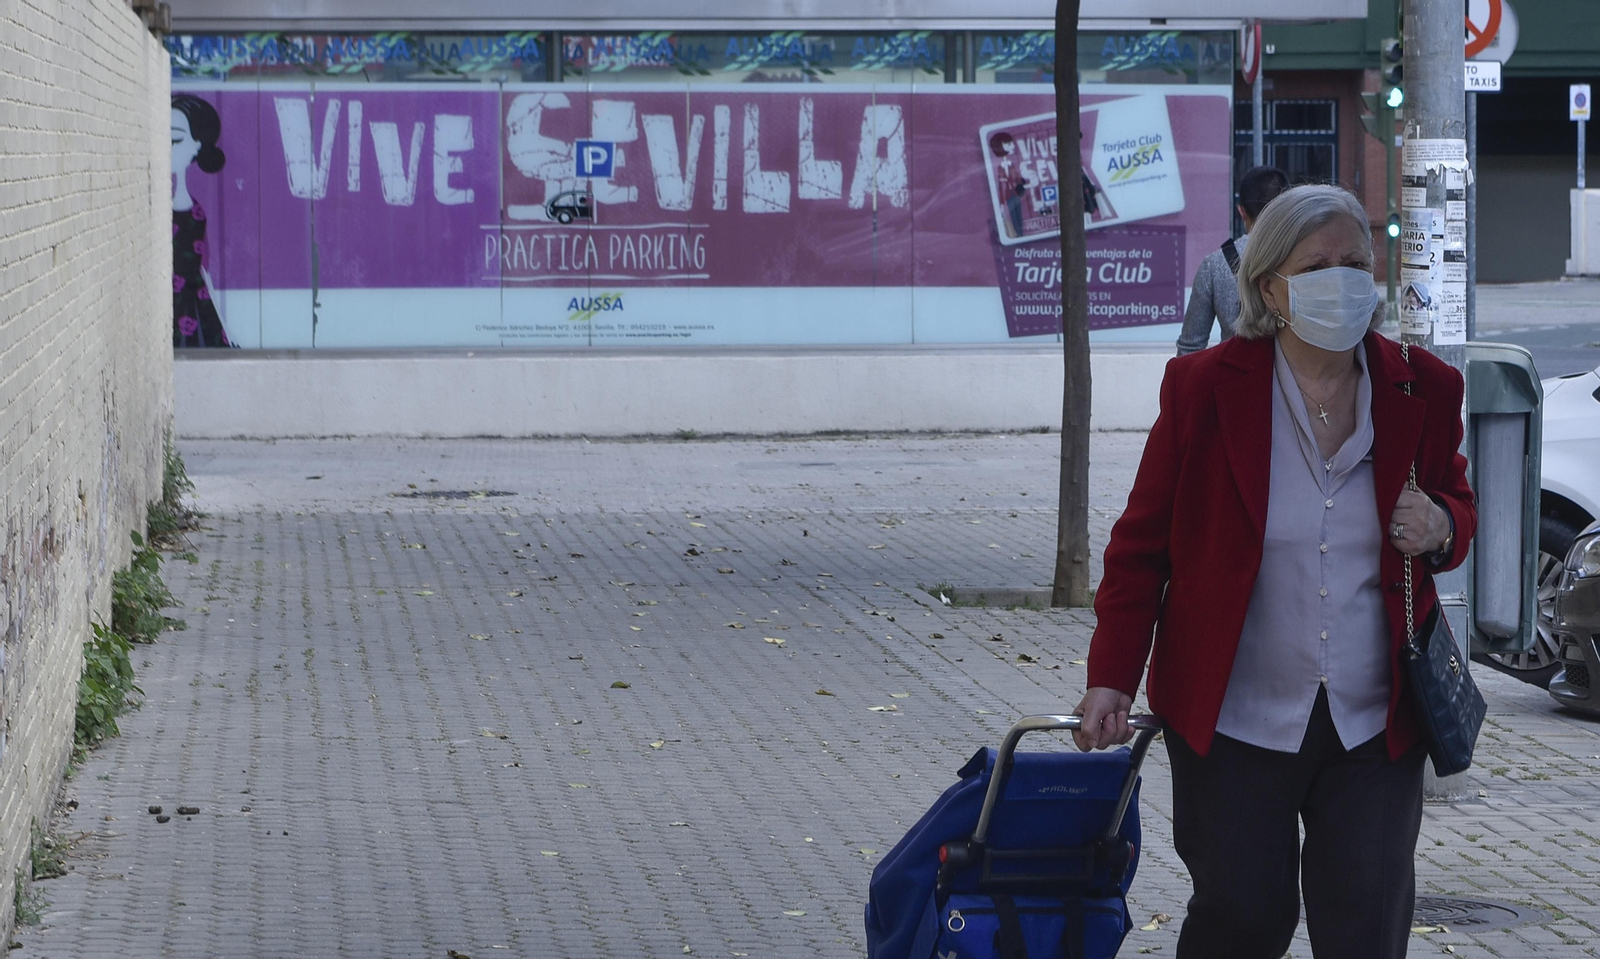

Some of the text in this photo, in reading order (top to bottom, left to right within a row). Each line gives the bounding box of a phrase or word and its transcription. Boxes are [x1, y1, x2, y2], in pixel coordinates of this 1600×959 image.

[460, 36, 540, 58] AUSSA
[725, 36, 804, 58] AUSSA
[853, 36, 931, 58] AUSSA
[1102, 36, 1181, 57] AUSSA
[1470, 77, 1497, 87] TAXIS
[1102, 133, 1163, 153] Tarjeta Club
[274, 92, 909, 219] VIVE SEVILLA
[583, 145, 608, 174] P
[1107, 148, 1163, 172] AUSSA
[485, 233, 706, 270] PRACTICA PARKING
[1014, 248, 1053, 260] Disfruta
[1085, 248, 1152, 261] ventajas de la
[1099, 262, 1152, 283] Club
[567, 296, 624, 312] AUSSA
[1099, 292, 1111, 301] EN
